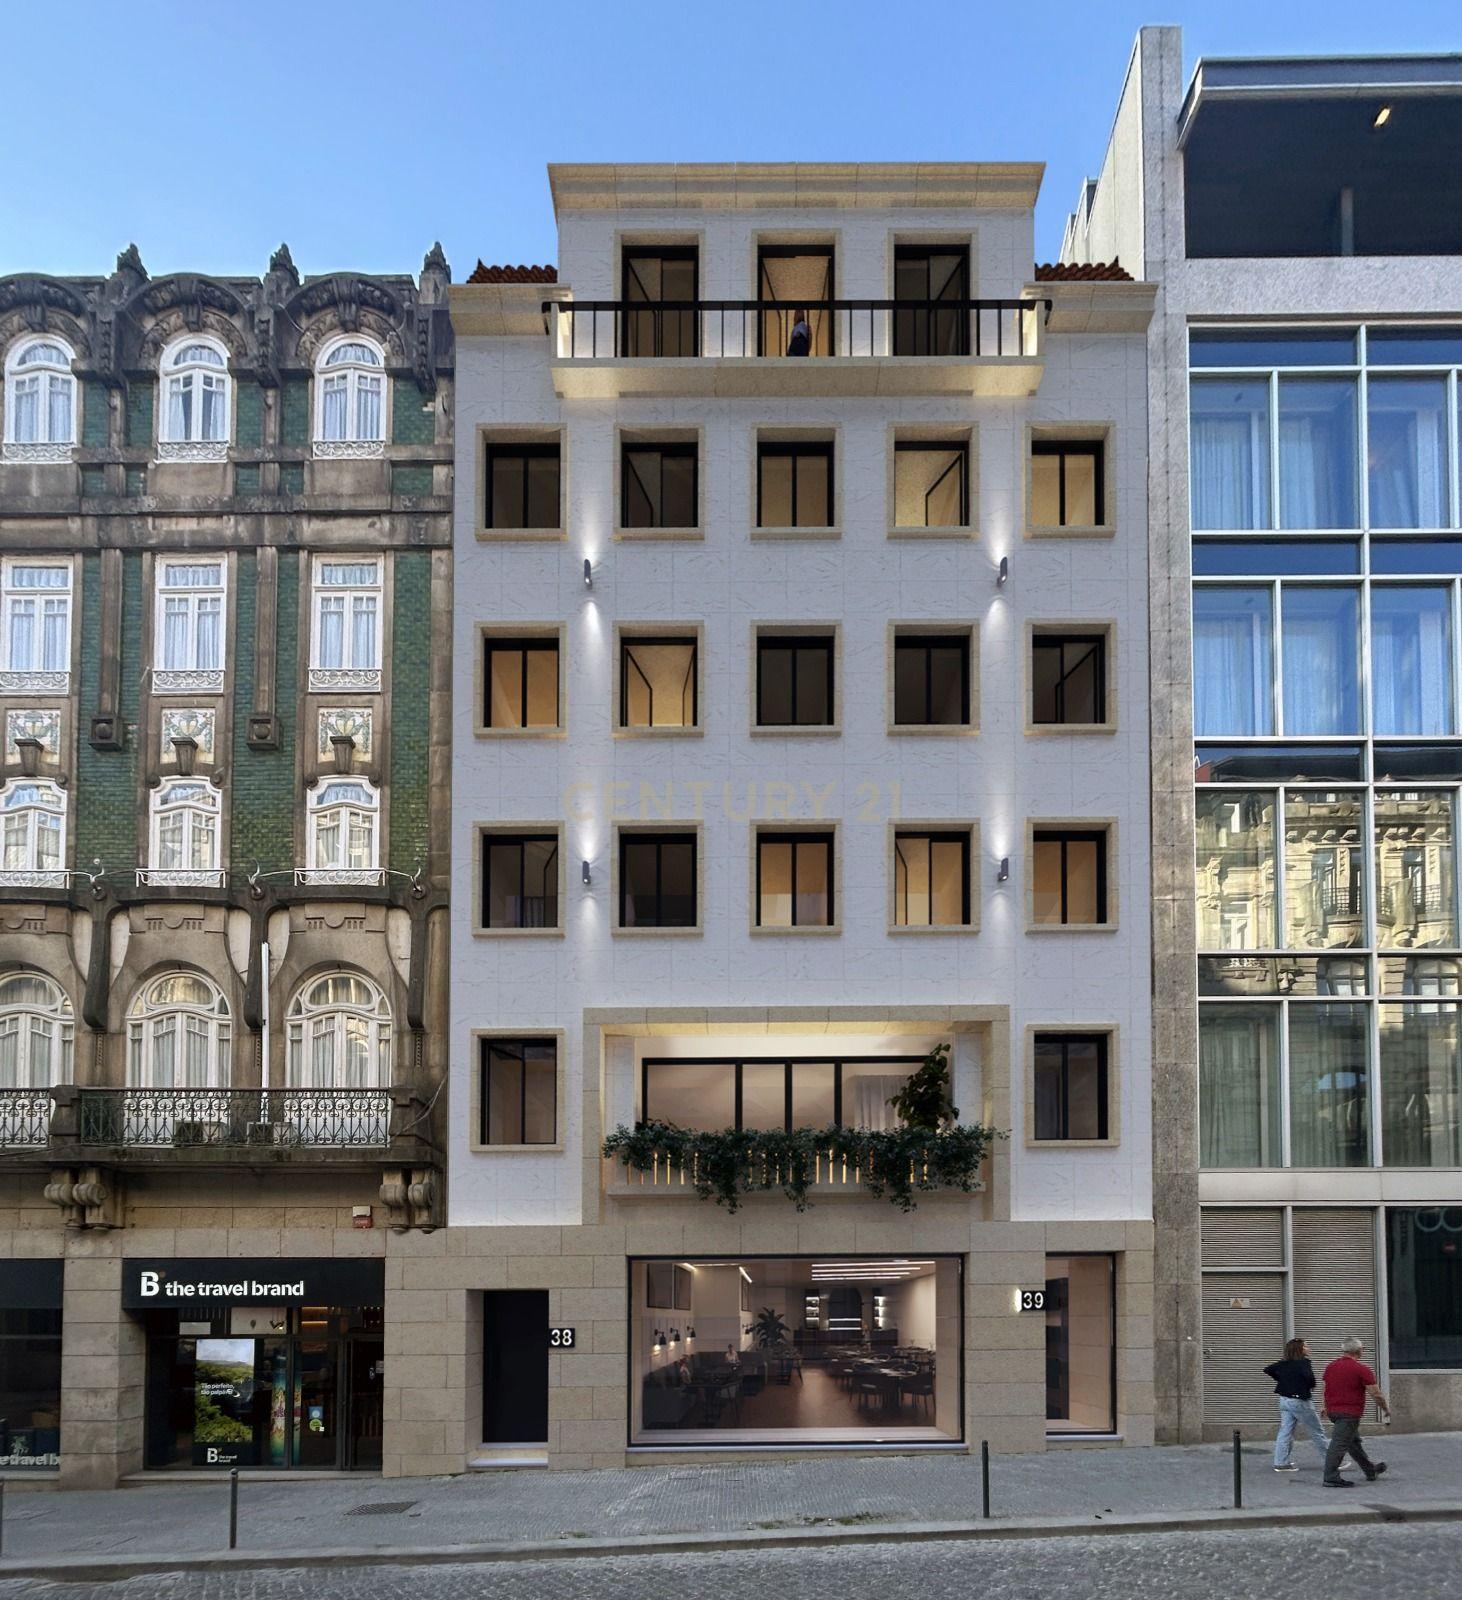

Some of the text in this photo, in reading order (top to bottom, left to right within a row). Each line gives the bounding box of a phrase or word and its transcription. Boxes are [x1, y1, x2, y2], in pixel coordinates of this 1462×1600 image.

[140, 1271, 304, 1297] B the travel brand
[1023, 1292, 1044, 1309] 39
[551, 1329, 572, 1346] 38
